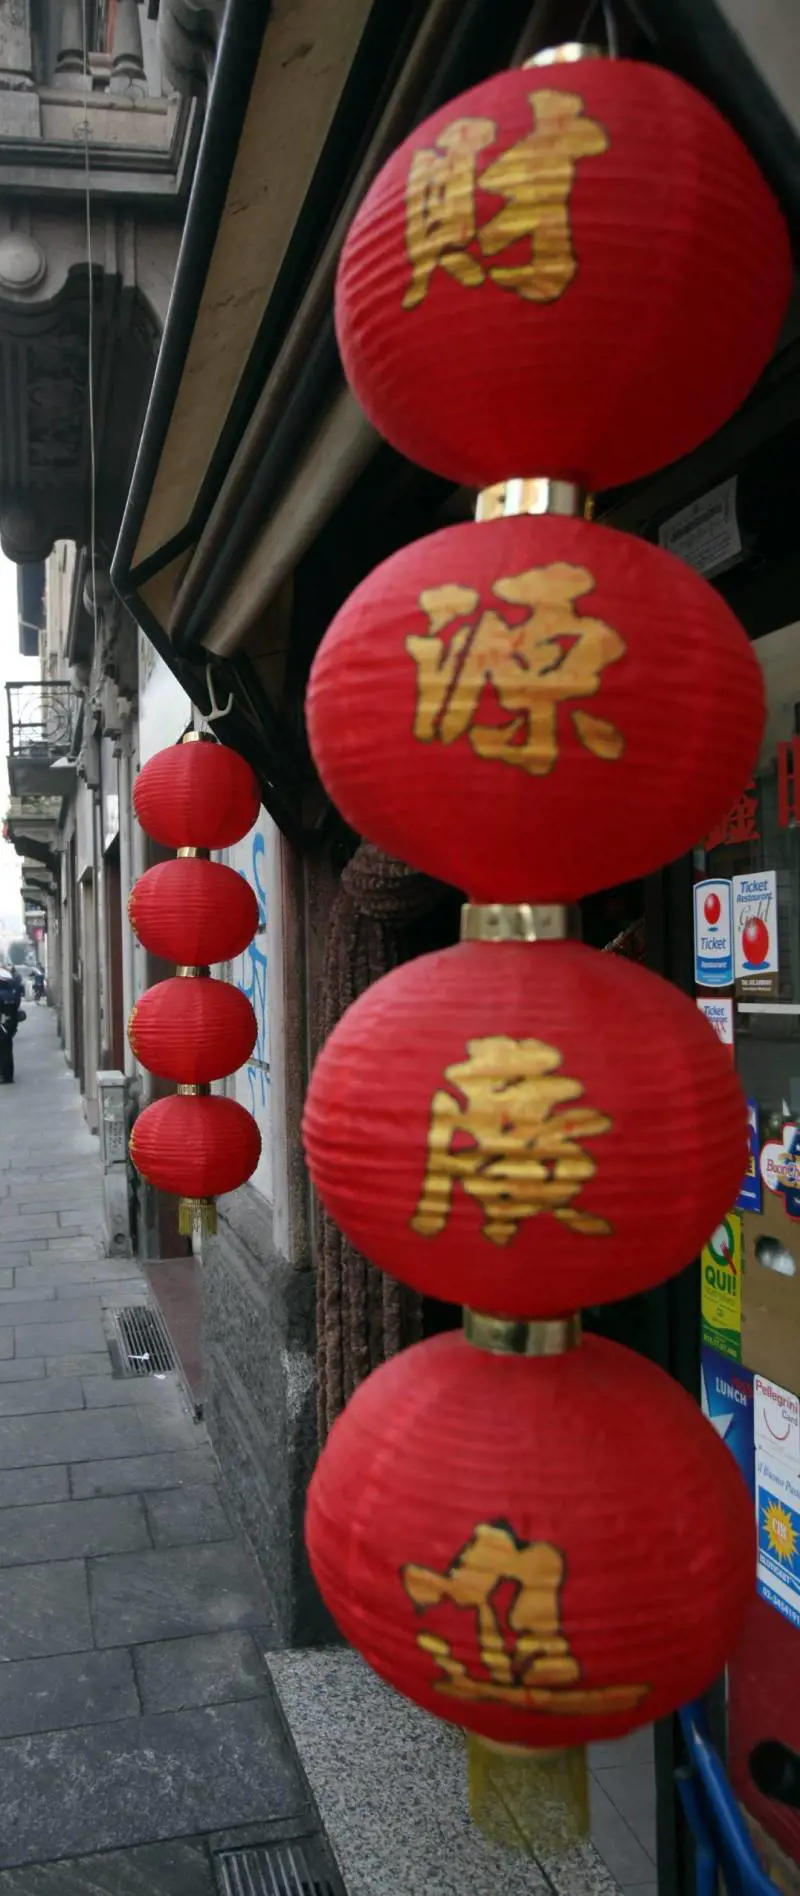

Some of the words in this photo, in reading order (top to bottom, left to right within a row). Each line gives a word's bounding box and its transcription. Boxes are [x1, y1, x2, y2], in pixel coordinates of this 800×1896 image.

[402, 88, 609, 311] 財
[405, 561, 626, 775] 源
[741, 880, 769, 893] Ticket
[700, 937, 727, 951] Ticket
[704, 1004, 725, 1016] Ticket
[705, 1265, 737, 1297] QUI!
[715, 1376, 747, 1407] LUNCH
[755, 1378, 799, 1414] Pellegrini
[781, 1408, 798, 1427] Card
